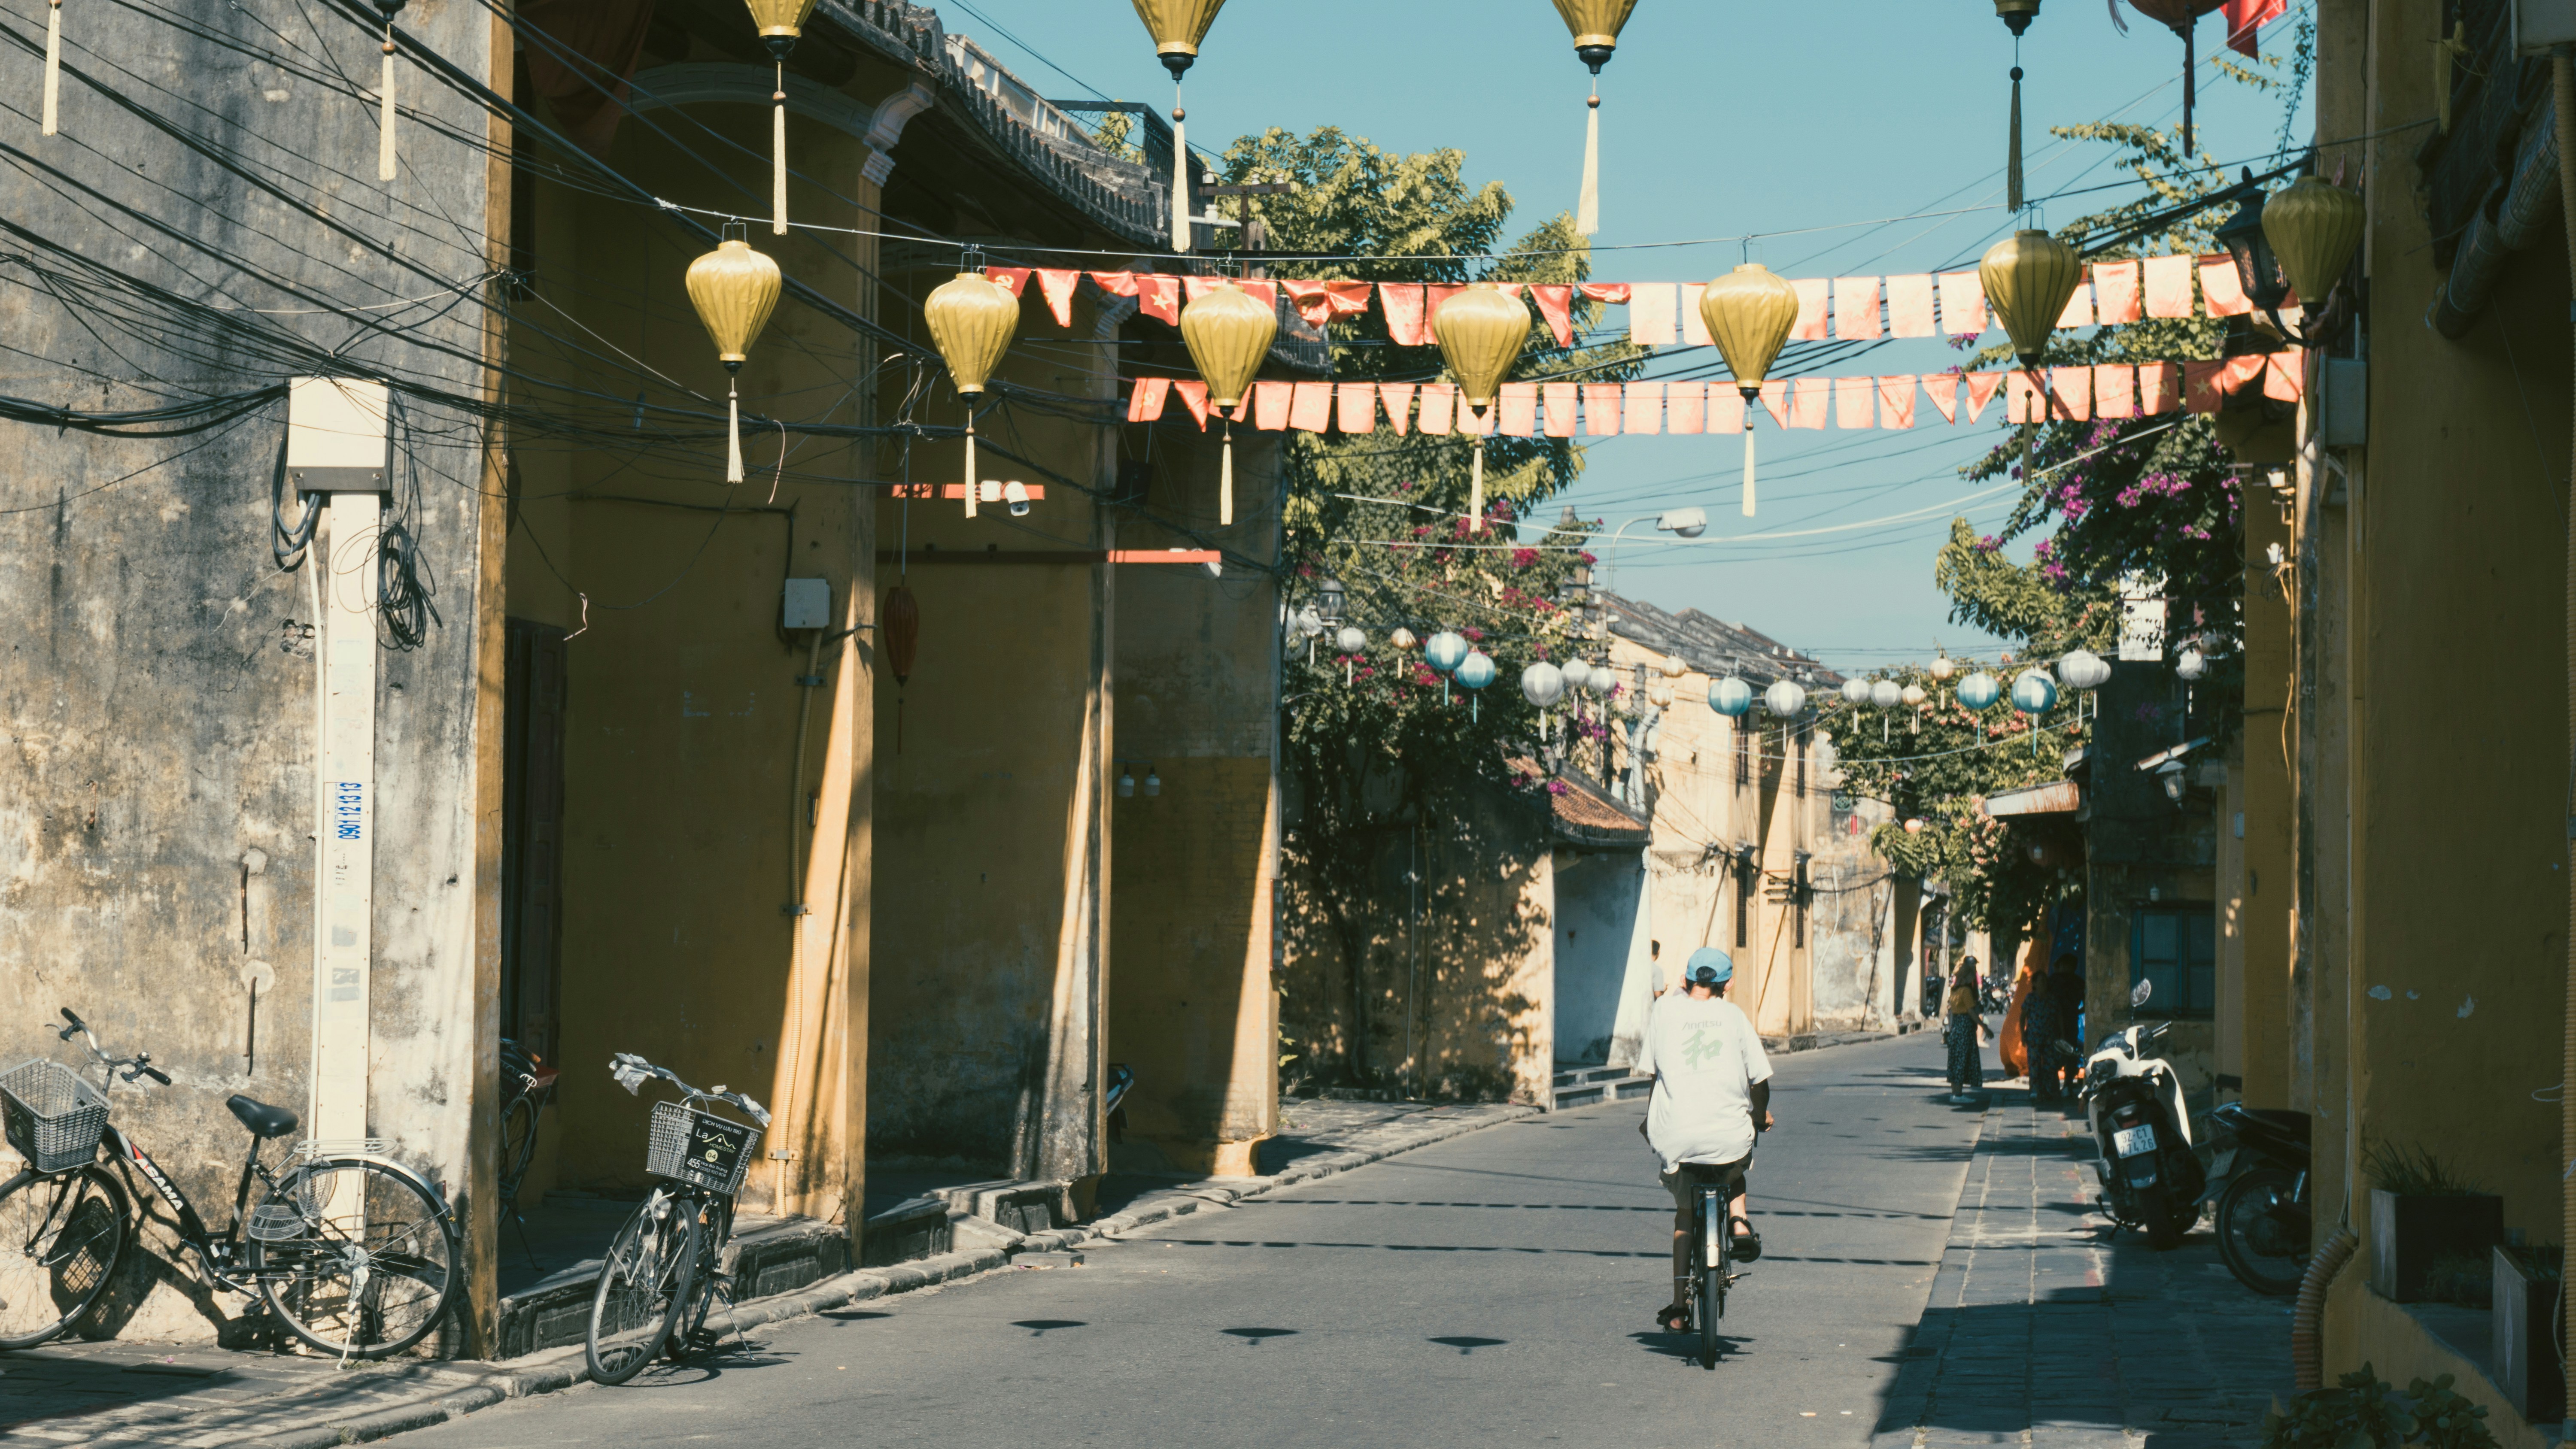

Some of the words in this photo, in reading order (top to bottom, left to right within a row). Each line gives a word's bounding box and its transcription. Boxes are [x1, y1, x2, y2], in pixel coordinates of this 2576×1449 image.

[337, 782, 362, 840] 0901.12.13.13
[1681, 1020, 1722, 1030] Anritsu
[1681, 1029, 1723, 1070] 和
[696, 1128, 708, 1139] La
[709, 1143, 735, 1154] HOMESTAY
[687, 1158, 701, 1169] 455
[134, 1158, 183, 1211] ASAMA
